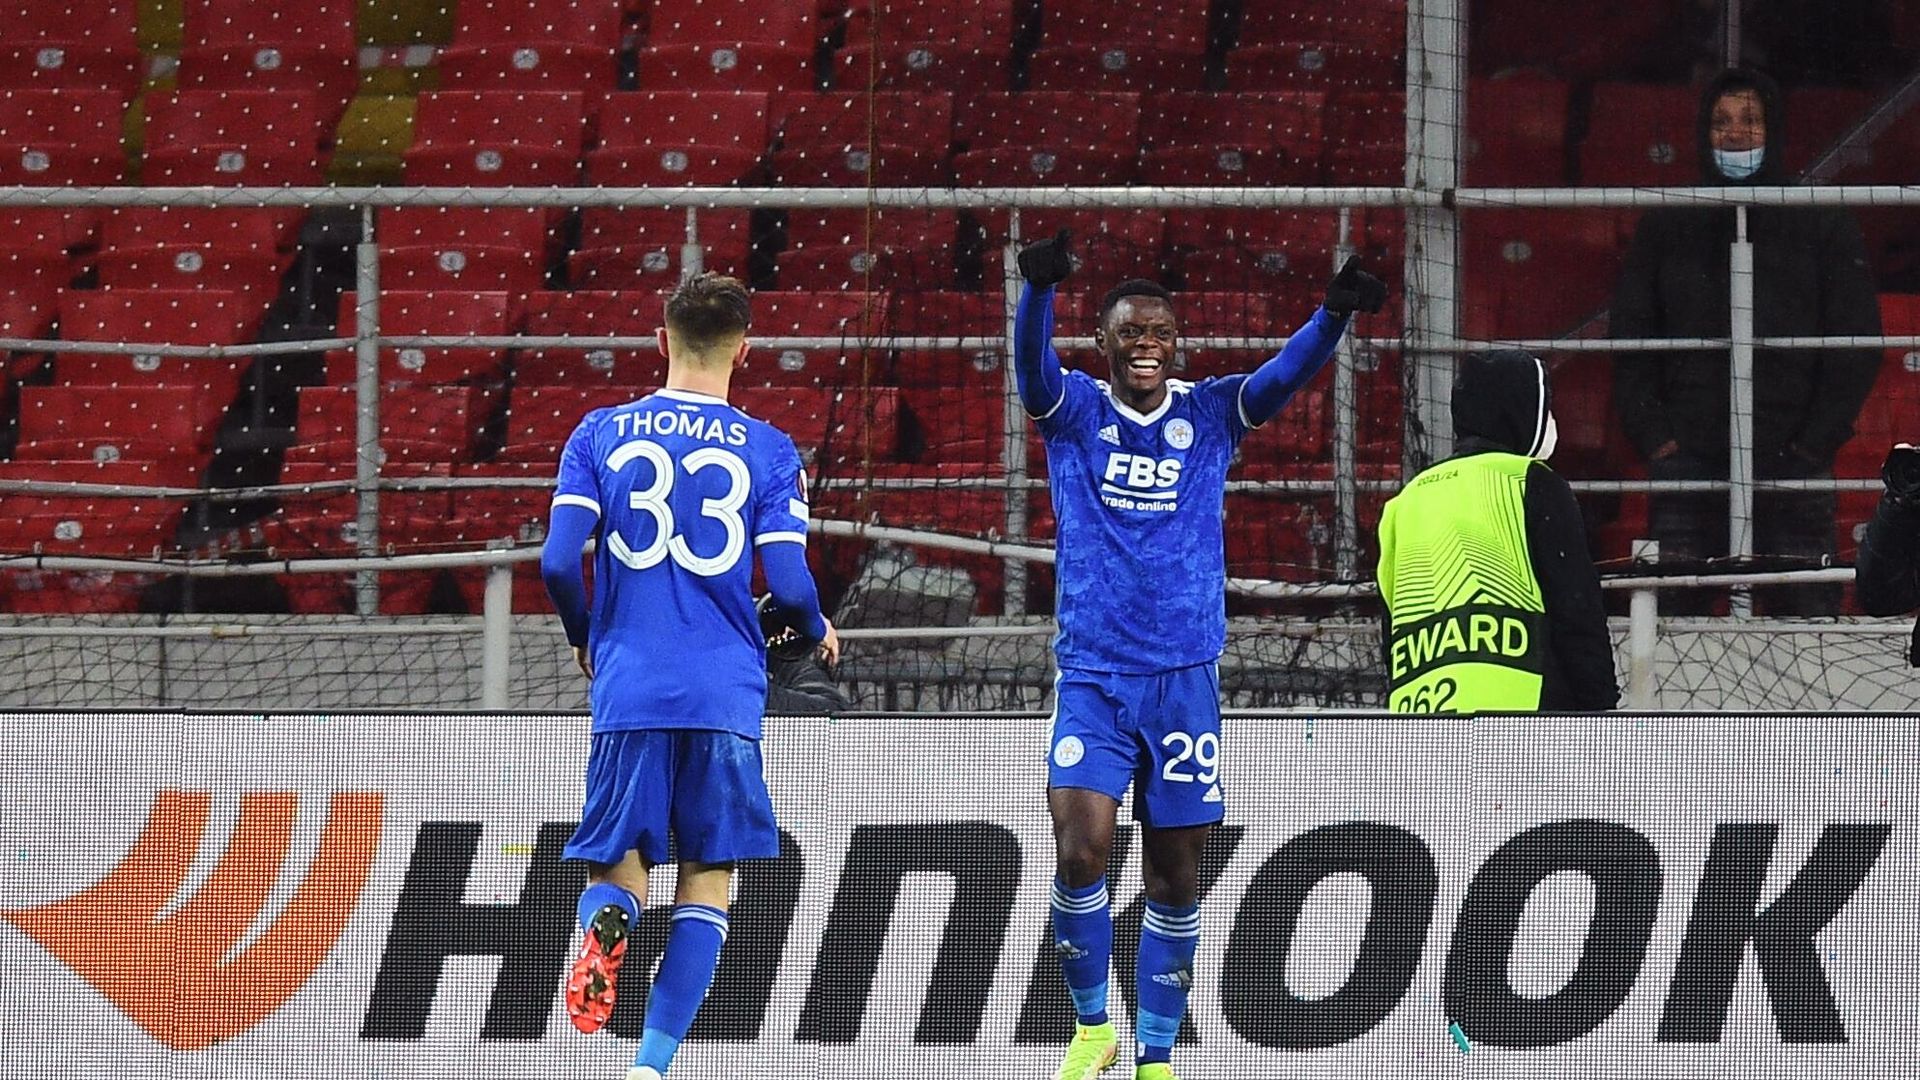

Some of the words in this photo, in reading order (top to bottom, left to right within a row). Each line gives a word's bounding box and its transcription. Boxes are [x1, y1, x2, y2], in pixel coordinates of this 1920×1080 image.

[612, 411, 747, 446] THOMAS
[1104, 452, 1182, 488] FBS
[606, 439, 751, 577] 33
[1136, 501, 1177, 512] online
[1161, 731, 1220, 785] 29
